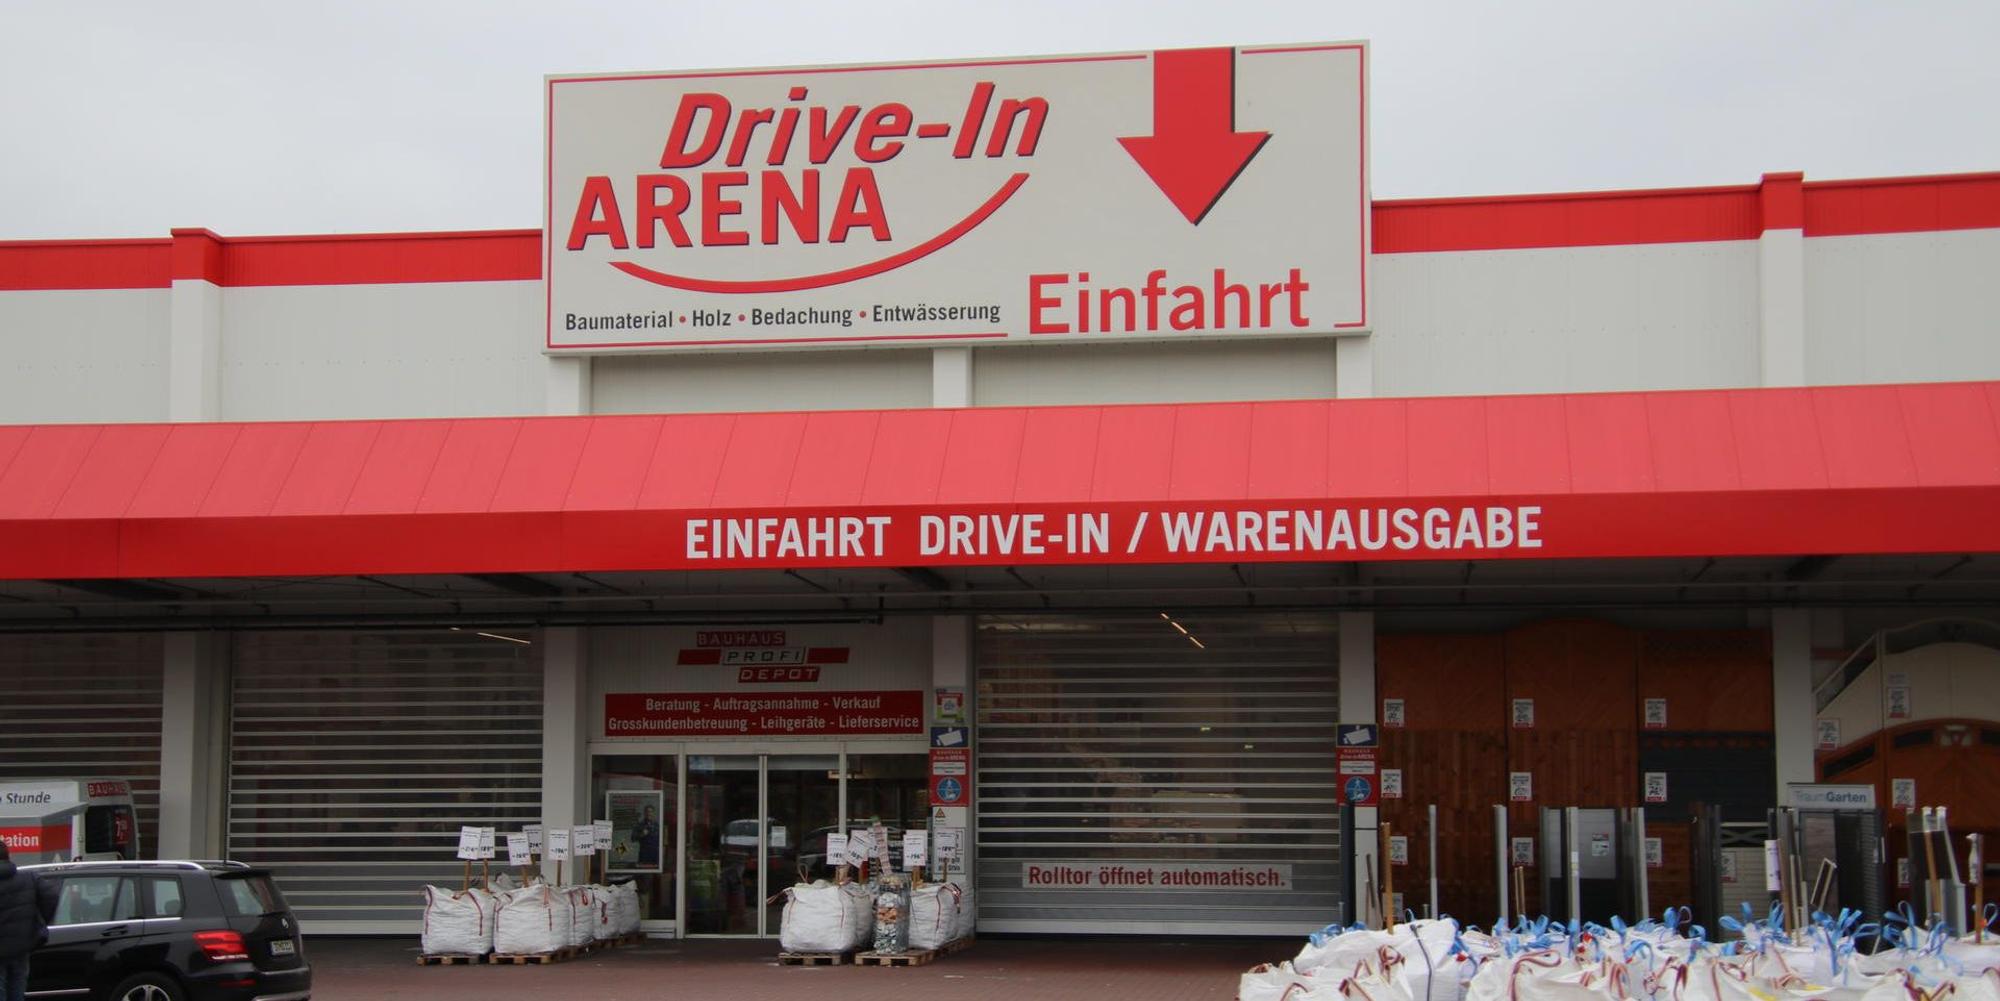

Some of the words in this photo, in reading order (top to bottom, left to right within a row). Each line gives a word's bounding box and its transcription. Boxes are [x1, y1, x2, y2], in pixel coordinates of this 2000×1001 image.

[660, 81, 1049, 170] Drive-In
[566, 166, 892, 251] ARENA
[1028, 267, 1310, 335] Einfahrt
[566, 310, 673, 331] Baumaterial
[692, 309, 731, 328] Holz
[751, 307, 853, 328] Bedachung
[872, 304, 1001, 323] Entwässerung
[686, 515, 891, 560] EINFAHRT
[919, 513, 1110, 556] DRIVE-IN
[1127, 512, 1149, 554] /
[1160, 506, 1543, 553] WARENAUSGABE
[698, 632, 784, 646] BAUHAUS
[727, 651, 801, 662] PROFI
[740, 668, 817, 681] DEPOT
[645, 698, 701, 713] Beratung
[712, 697, 820, 713] Auftragsannahme
[832, 696, 881, 710] Verkauf
[608, 716, 748, 732] Grosskundenbetreuung
[760, 715, 826, 732] Leihgeräte
[838, 714, 919, 729] Lieferservice
[6, 792, 51, 804] Stunde
[1029, 866, 1093, 885] Rolltor
[1099, 866, 1154, 885] öffnet
[1160, 867, 1287, 887] automatisch.
